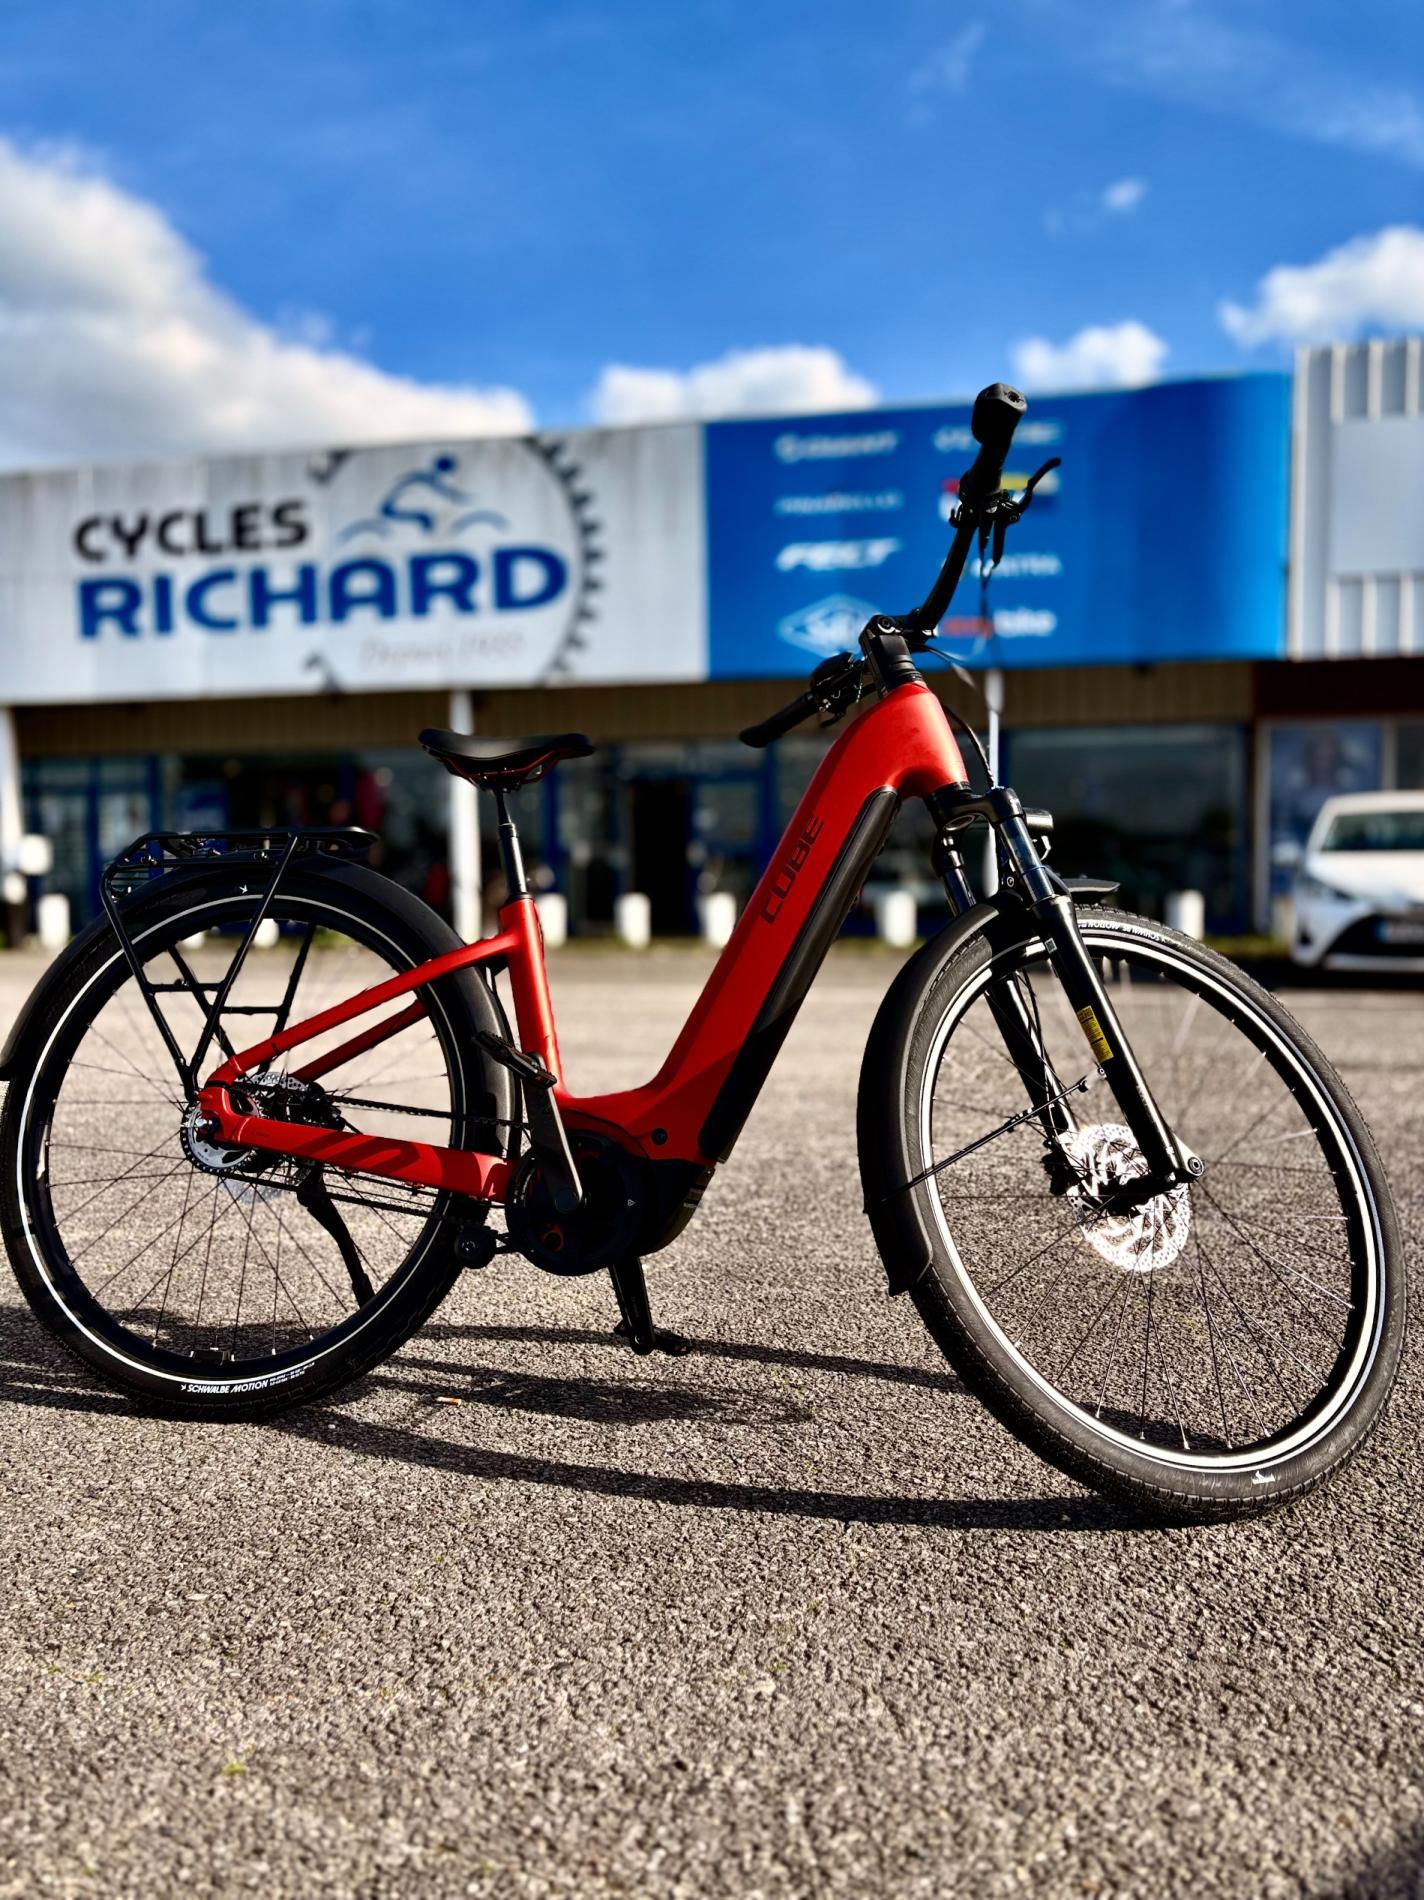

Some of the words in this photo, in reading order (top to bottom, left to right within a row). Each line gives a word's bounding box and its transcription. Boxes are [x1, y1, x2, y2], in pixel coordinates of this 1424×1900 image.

[74, 501, 309, 562] CYCLES
[79, 546, 569, 638] RICHARD
[760, 816, 825, 924] CUBE
[187, 1384, 230, 1393] SCHWALBE
[230, 1379, 268, 1393] MOTION
